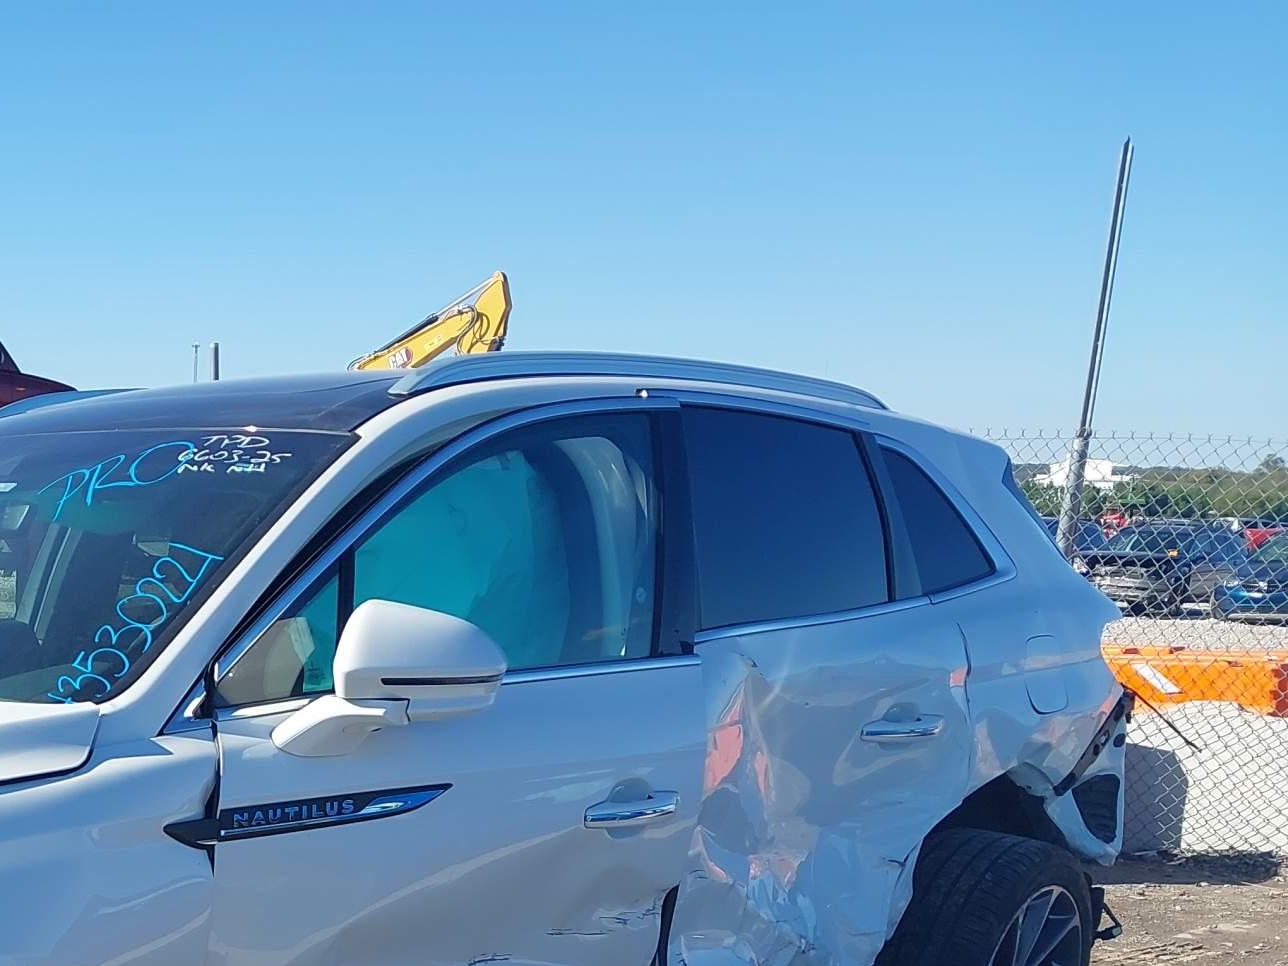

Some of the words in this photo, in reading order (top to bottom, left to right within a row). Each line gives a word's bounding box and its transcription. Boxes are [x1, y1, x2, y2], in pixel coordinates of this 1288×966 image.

[389, 348, 410, 368] CAT
[200, 434, 270, 448] TPD
[233, 799, 355, 828] NAUTILUS
